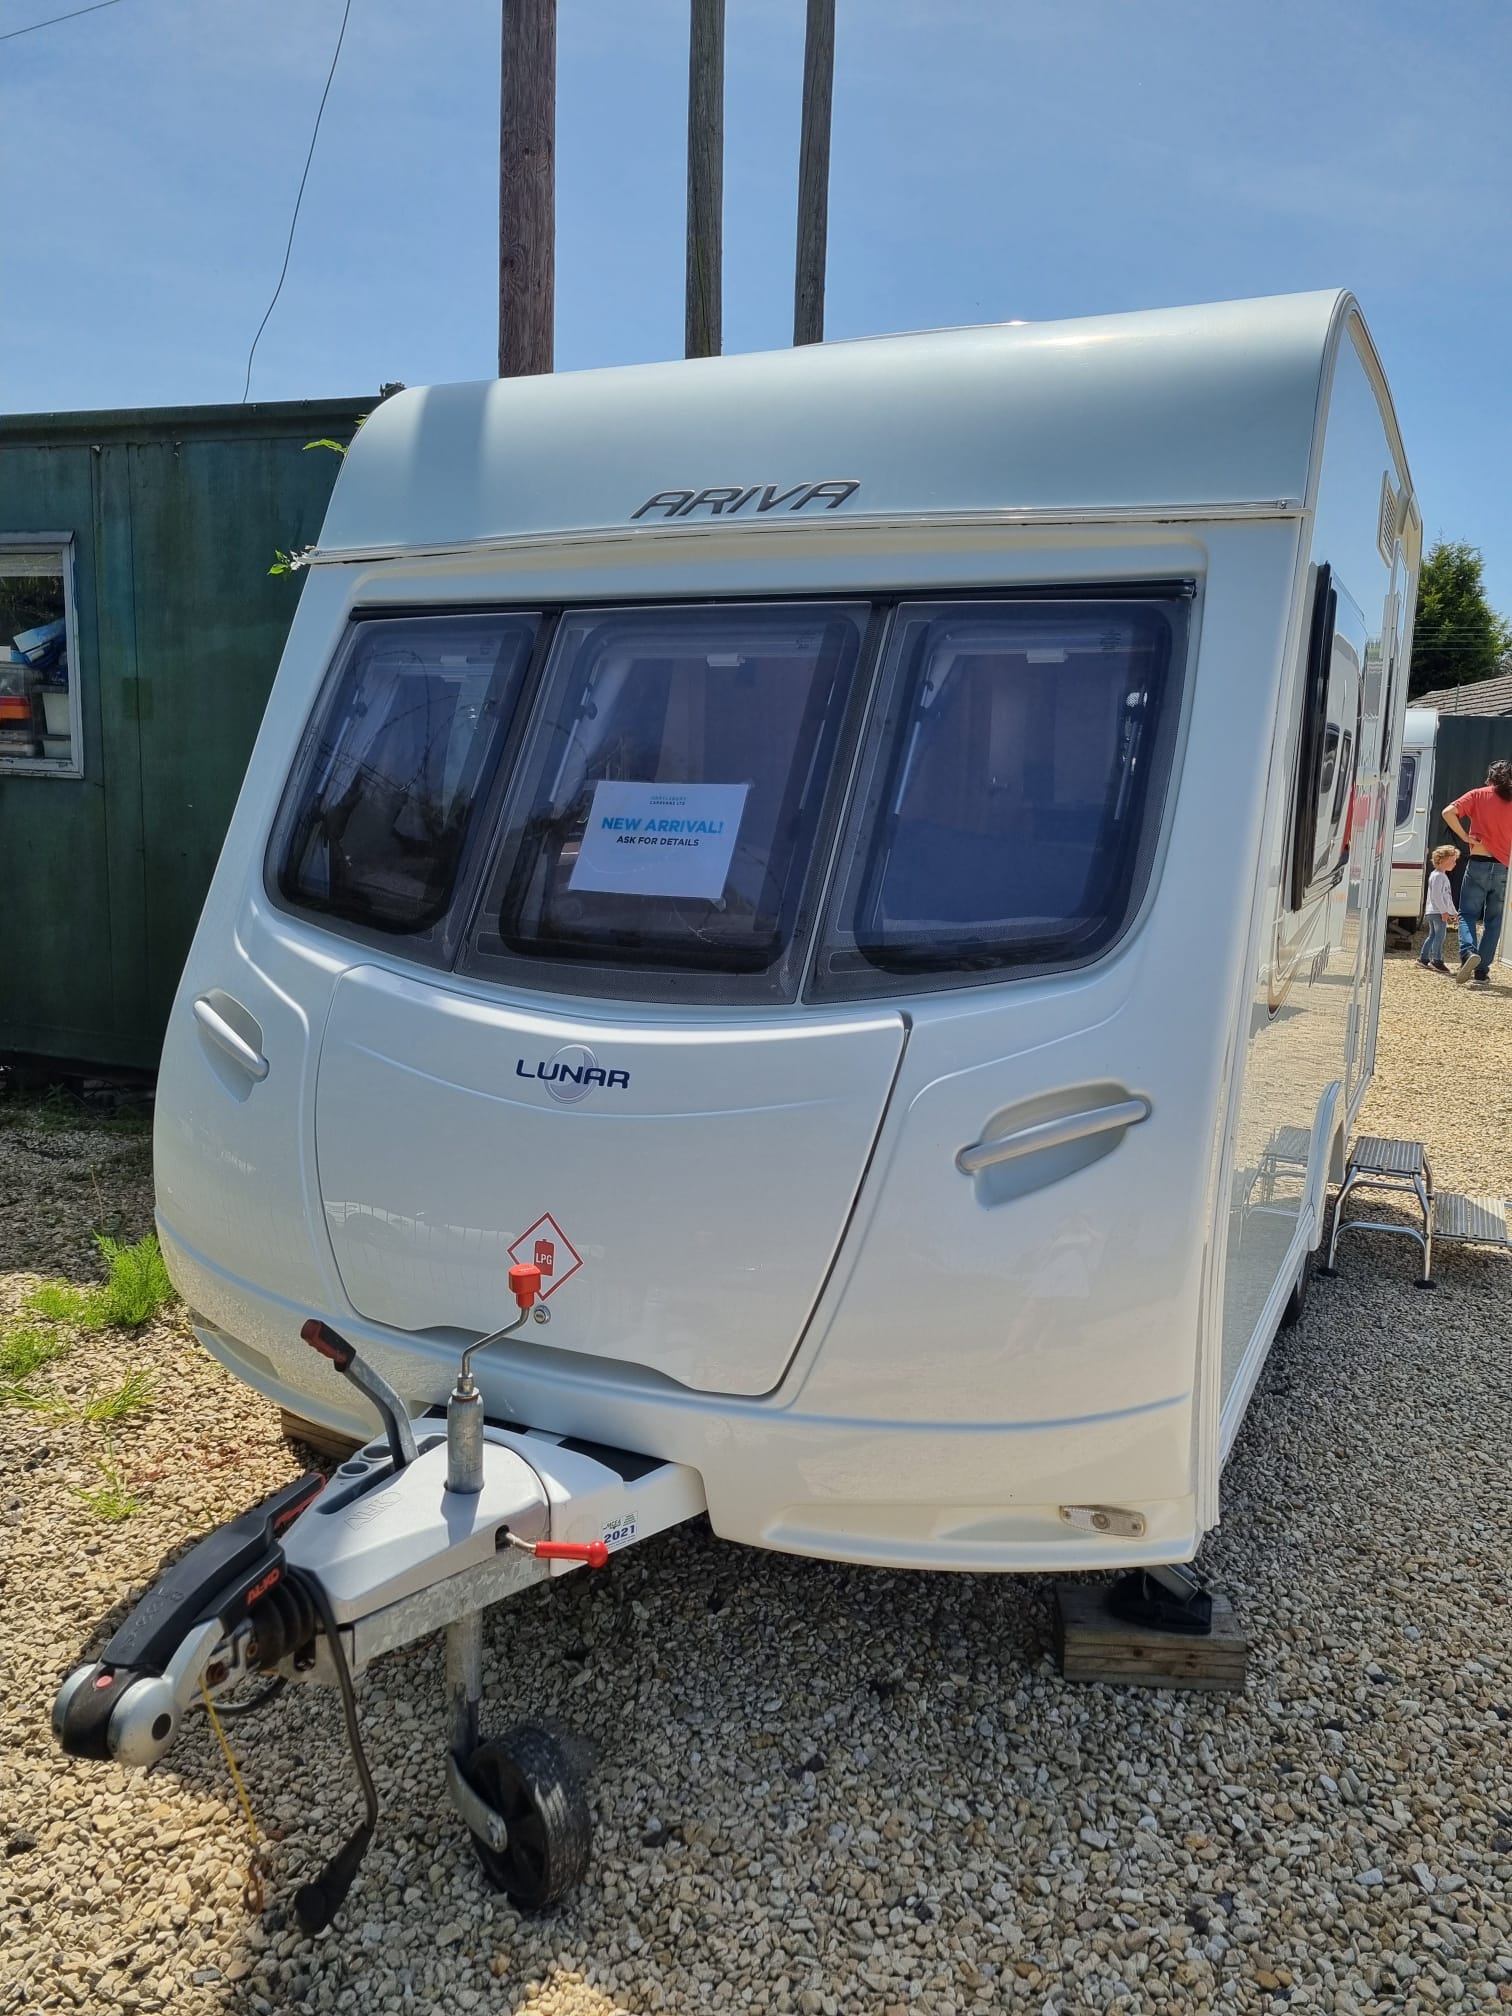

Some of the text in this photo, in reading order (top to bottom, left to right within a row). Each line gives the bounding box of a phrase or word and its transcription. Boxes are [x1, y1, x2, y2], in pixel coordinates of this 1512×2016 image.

[630, 479, 861, 519] ARIVA
[601, 816, 724, 834] NEW ARRIVAL!
[616, 836, 700, 847] ASK FOR DETAILS
[515, 1059, 631, 1089] LUNAR
[535, 1252, 553, 1265] LPG
[603, 1524, 635, 1543] 2021
